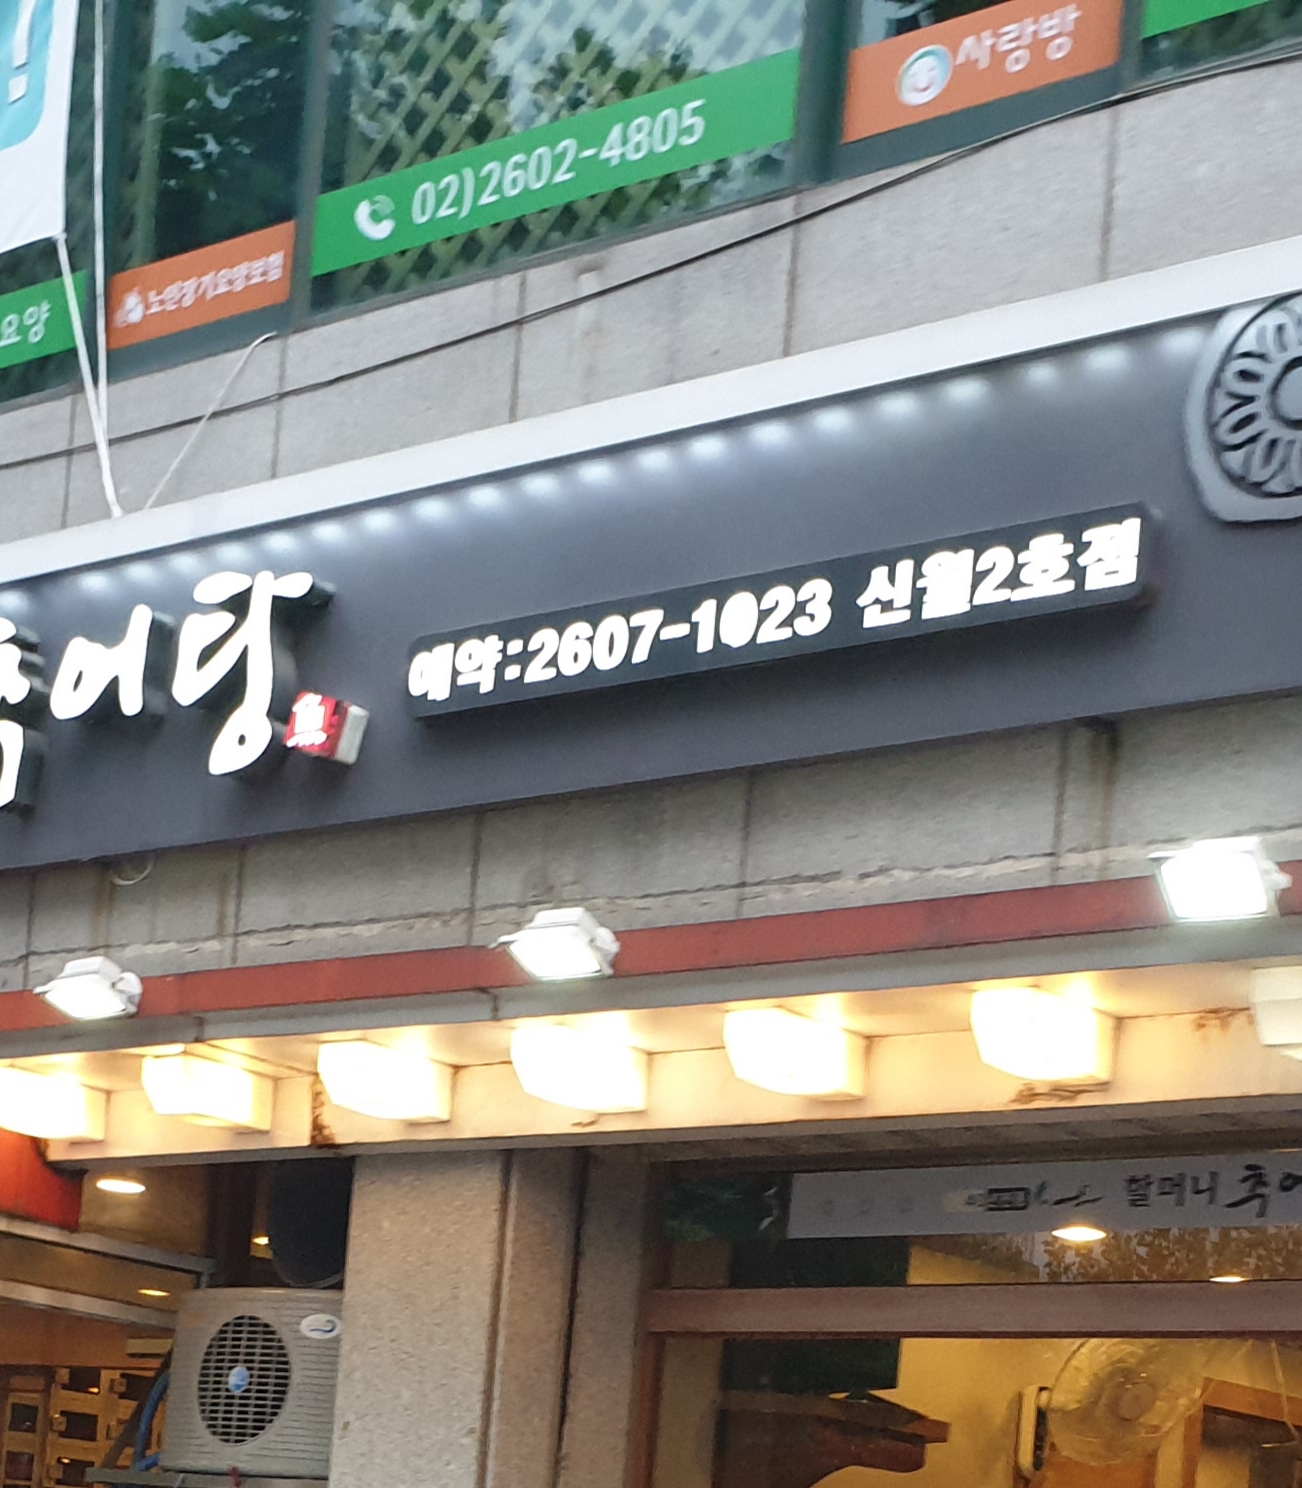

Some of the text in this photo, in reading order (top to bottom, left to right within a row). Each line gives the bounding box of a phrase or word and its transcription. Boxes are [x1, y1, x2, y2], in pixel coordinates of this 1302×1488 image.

[954, 4, 1080, 74] 사랑방
[411, 100, 707, 224] 02)2602-4805
[856, 517, 1142, 630] 신월2호점
